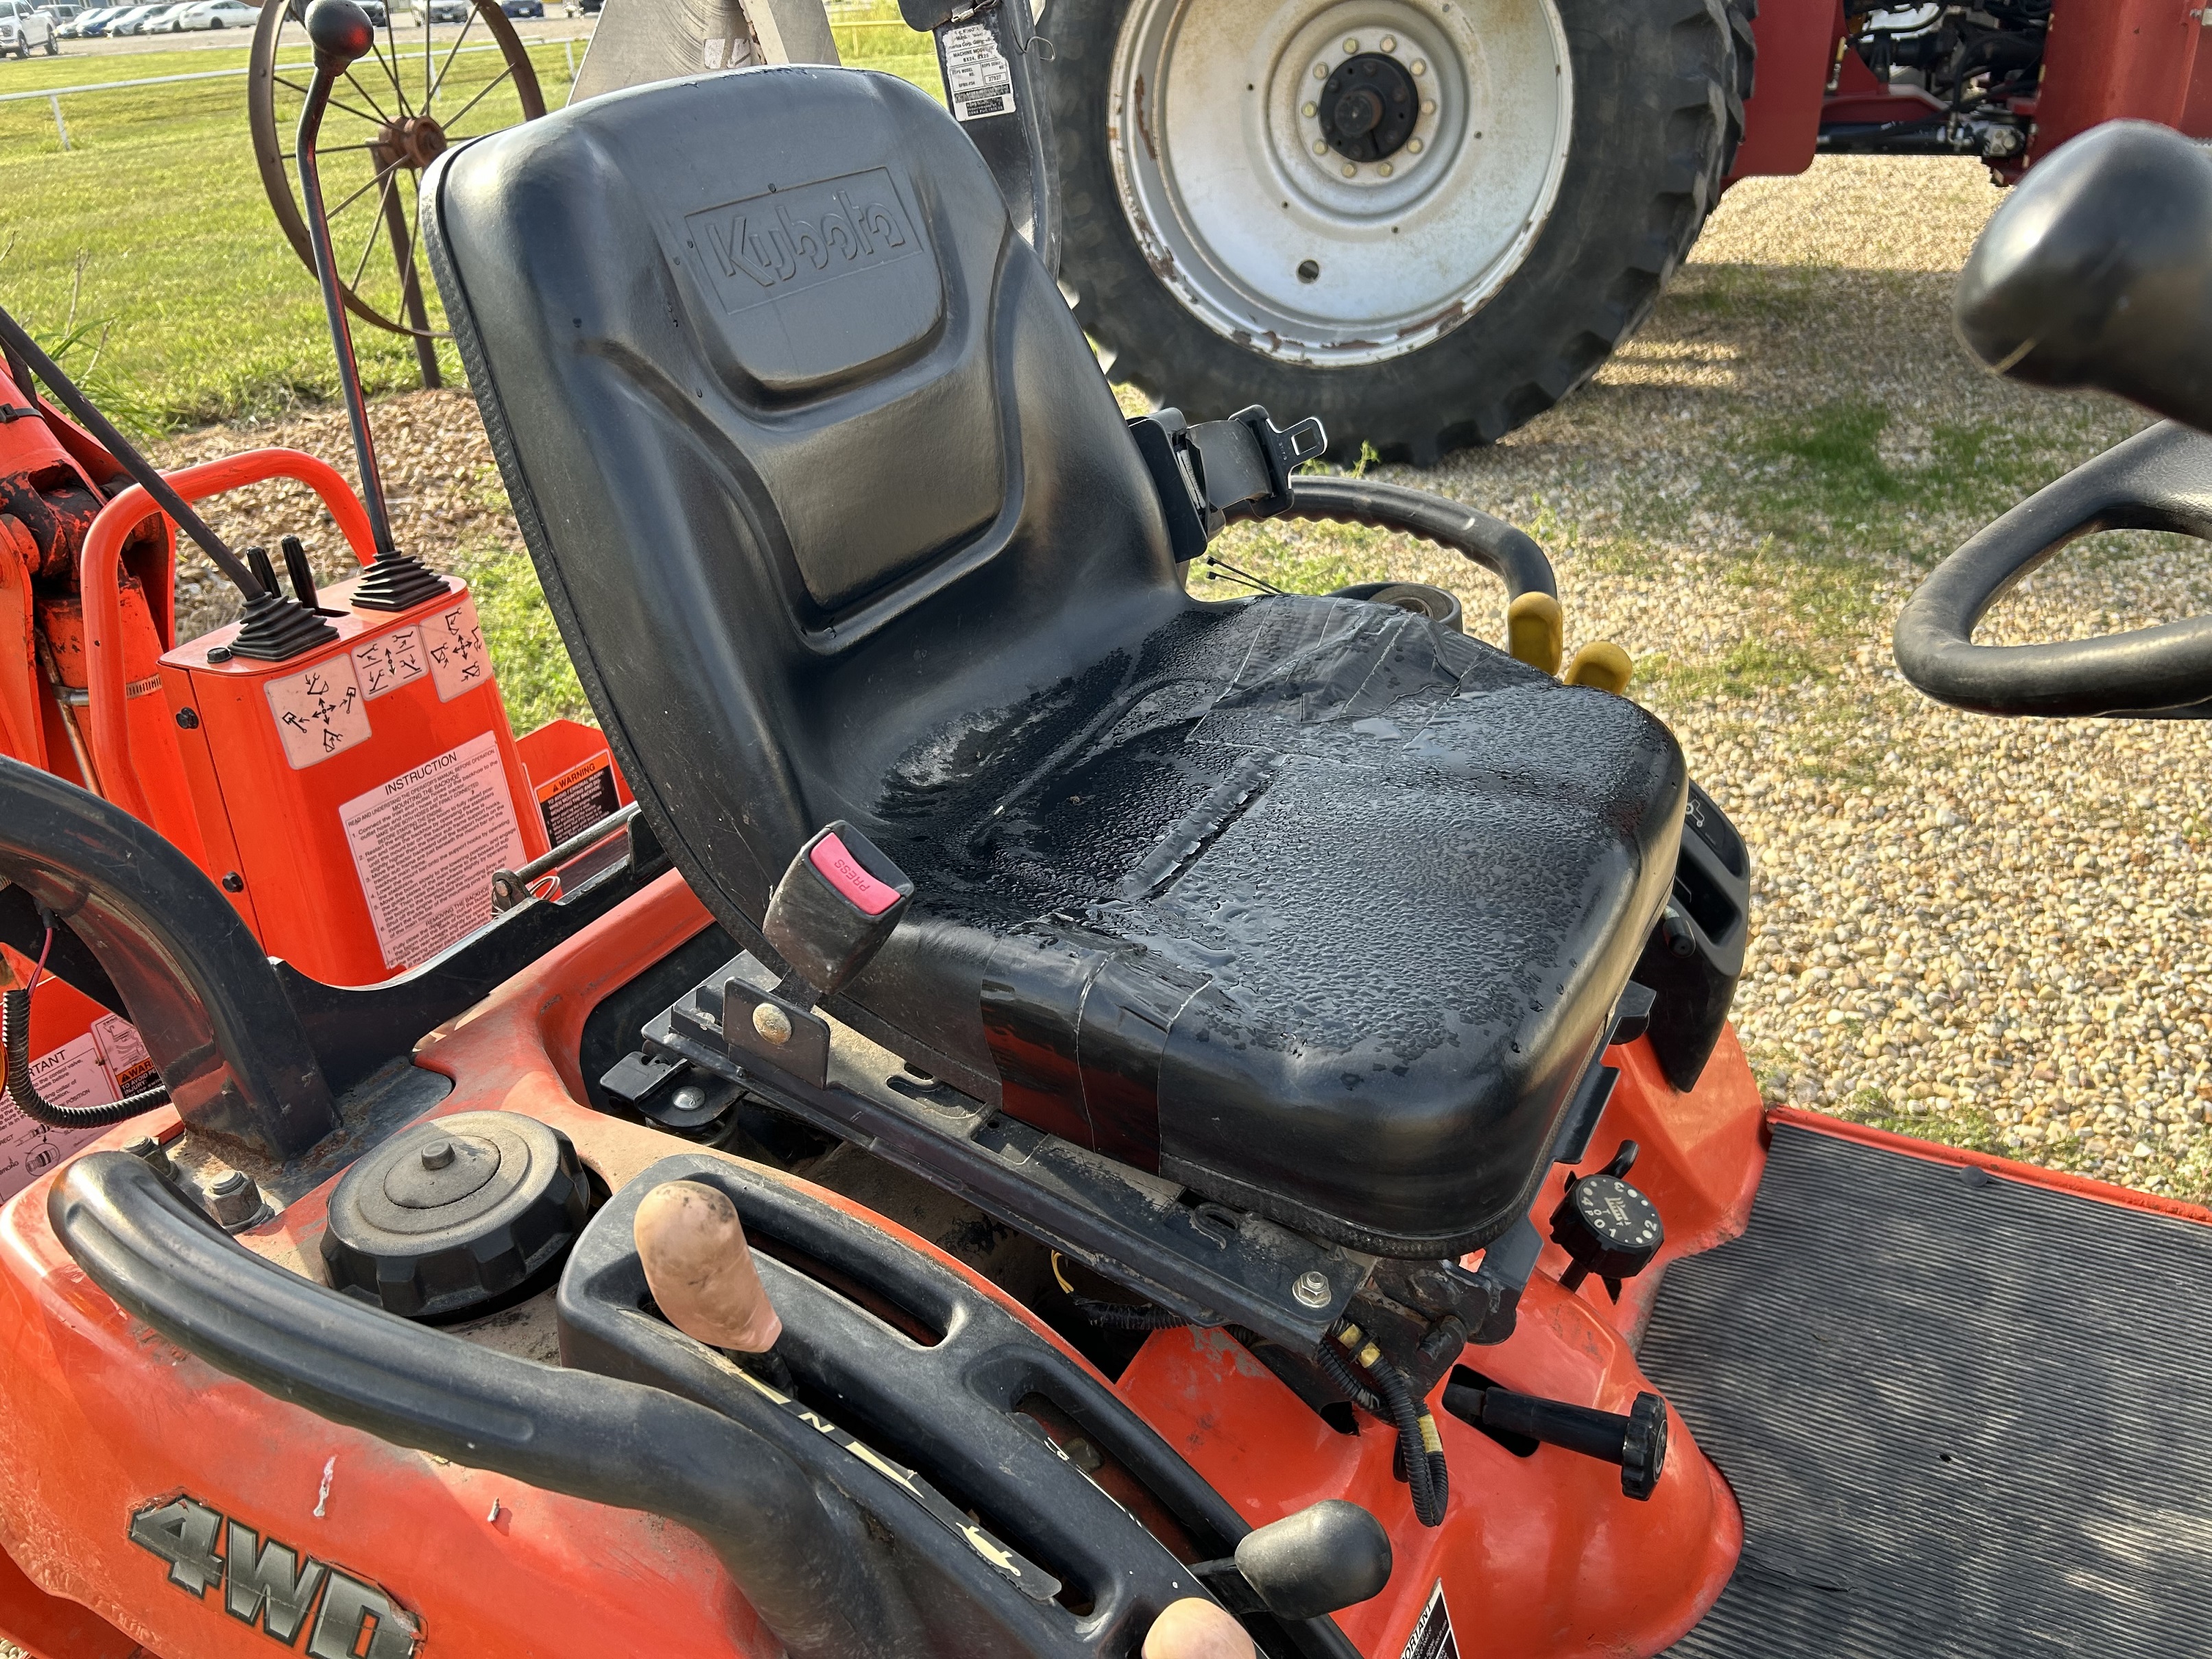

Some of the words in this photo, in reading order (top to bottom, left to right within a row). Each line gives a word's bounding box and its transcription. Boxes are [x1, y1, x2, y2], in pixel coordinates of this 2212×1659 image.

[953, 49, 972, 58] MACHINE
[706, 191, 906, 288] Kubota
[385, 751, 457, 795] INSTRUCTION
[559, 763, 595, 788] WARNING
[392, 792, 422, 811] MOUNTING
[422, 787, 431, 795] THE
[434, 773, 459, 790] BACKHOE
[834, 859, 871, 892] PRESS
[49, 1066, 67, 1079] control
[52, 1071, 69, 1083] before
[121, 1082, 130, 1091] TO
[131, 1074, 148, 1086] AVOID
[44, 1092, 56, 1100] ding
[56, 1083, 71, 1093] collar
[66, 1088, 91, 1104] POSITION
[4, 1113, 16, 1122] sure
[1613, 1181, 1624, 1193] 3
[1581, 1196, 1594, 1207] 4
[1594, 1218, 1606, 1228] 0
[1644, 1220, 1657, 1232] 2
[1608, 1228, 1617, 1237] 1
[797, 1411, 834, 1433] N
[129, 1490, 426, 1659] 4WD
